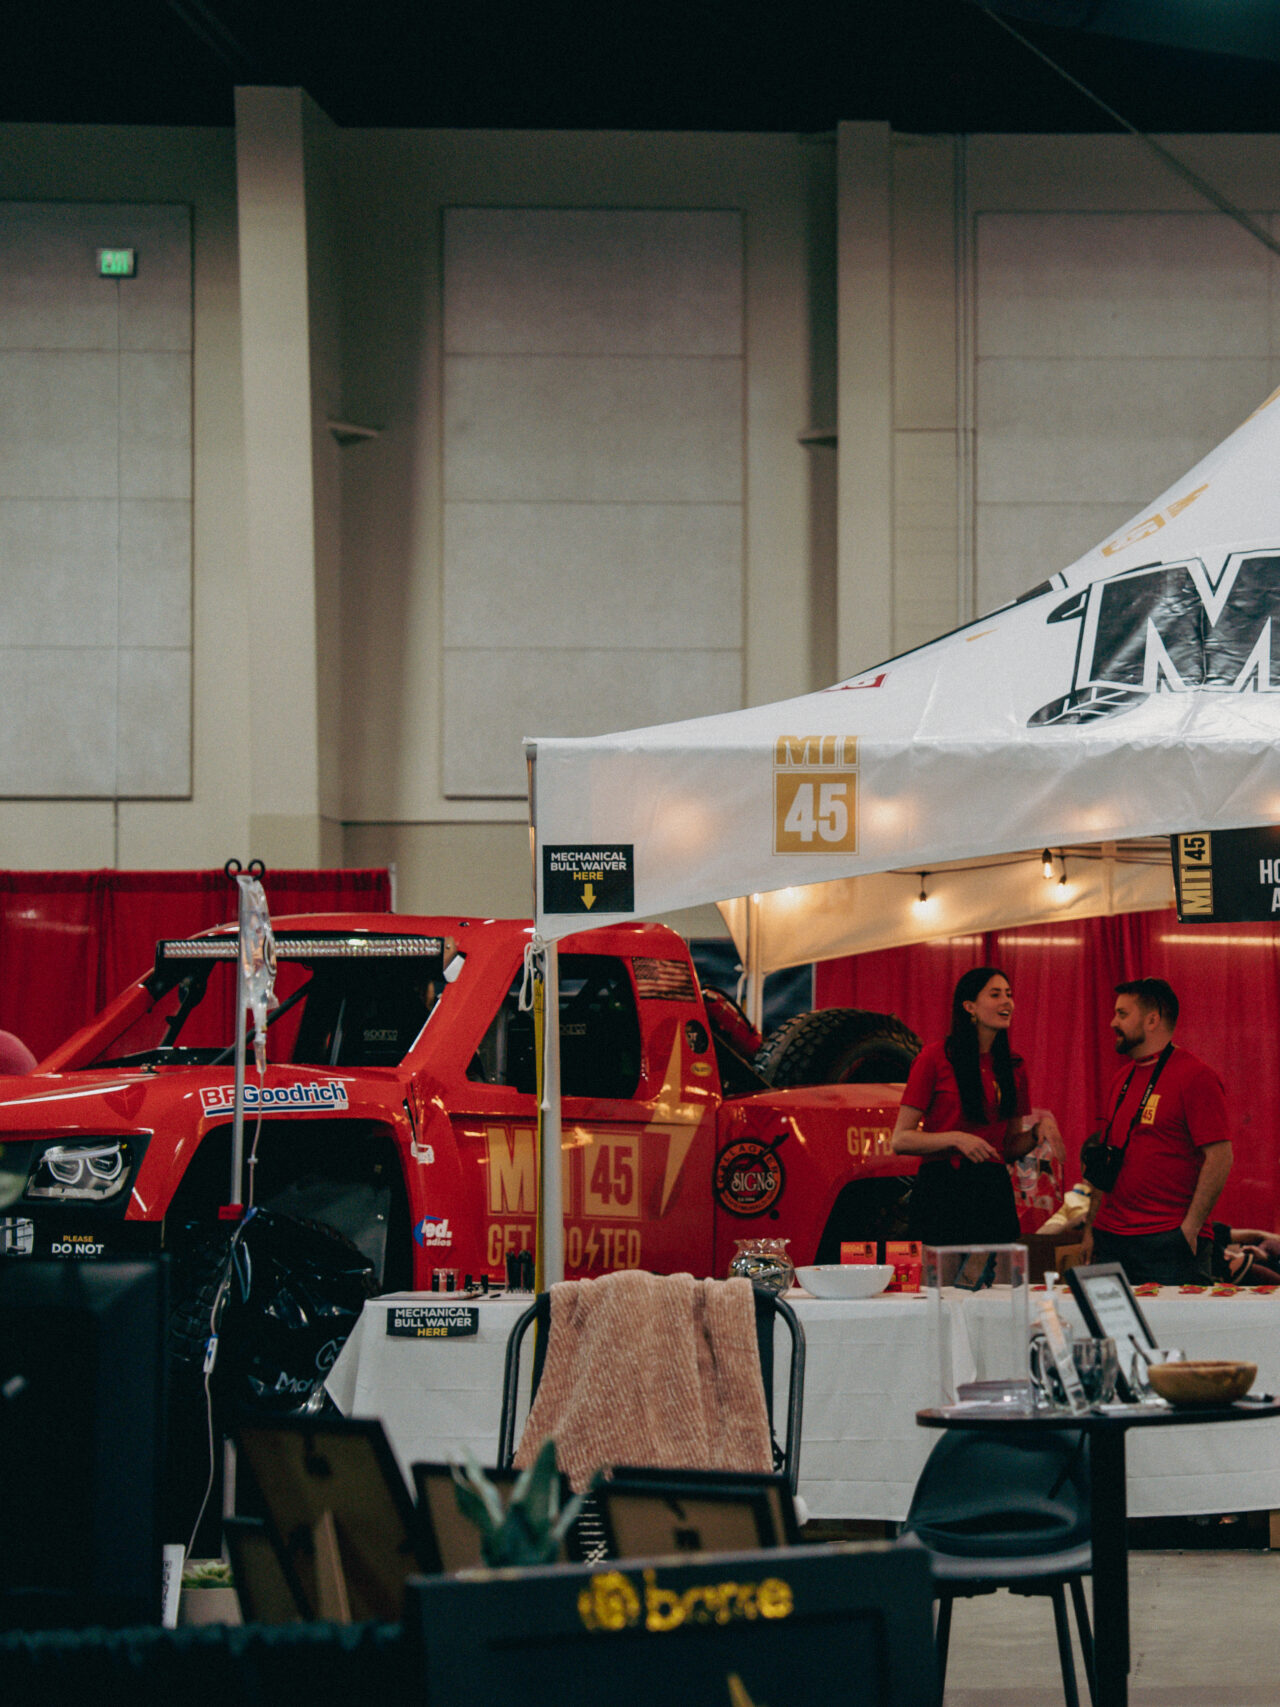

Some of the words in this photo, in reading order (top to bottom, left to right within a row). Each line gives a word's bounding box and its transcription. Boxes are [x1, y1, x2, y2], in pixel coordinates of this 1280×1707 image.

[784, 783, 848, 842] 45
[1184, 836, 1206, 861] 45
[551, 852, 627, 862] MECHANICAL
[550, 862, 580, 872] BULL
[581, 861, 627, 871] WAIVER
[573, 871, 604, 881] HERE
[1181, 868, 1213, 914] MIT
[201, 1082, 348, 1107] BFGoodrich
[590, 1144, 634, 1206] 45
[731, 1171, 776, 1191] SIGNS
[63, 1235, 93, 1243] PLEASE
[51, 1243, 72, 1254] DO
[75, 1244, 104, 1255] NOT
[395, 1308, 472, 1318] MECHANICAL
[394, 1318, 424, 1328] BULL
[425, 1317, 472, 1327] WAIVER
[417, 1327, 449, 1337] HERE
